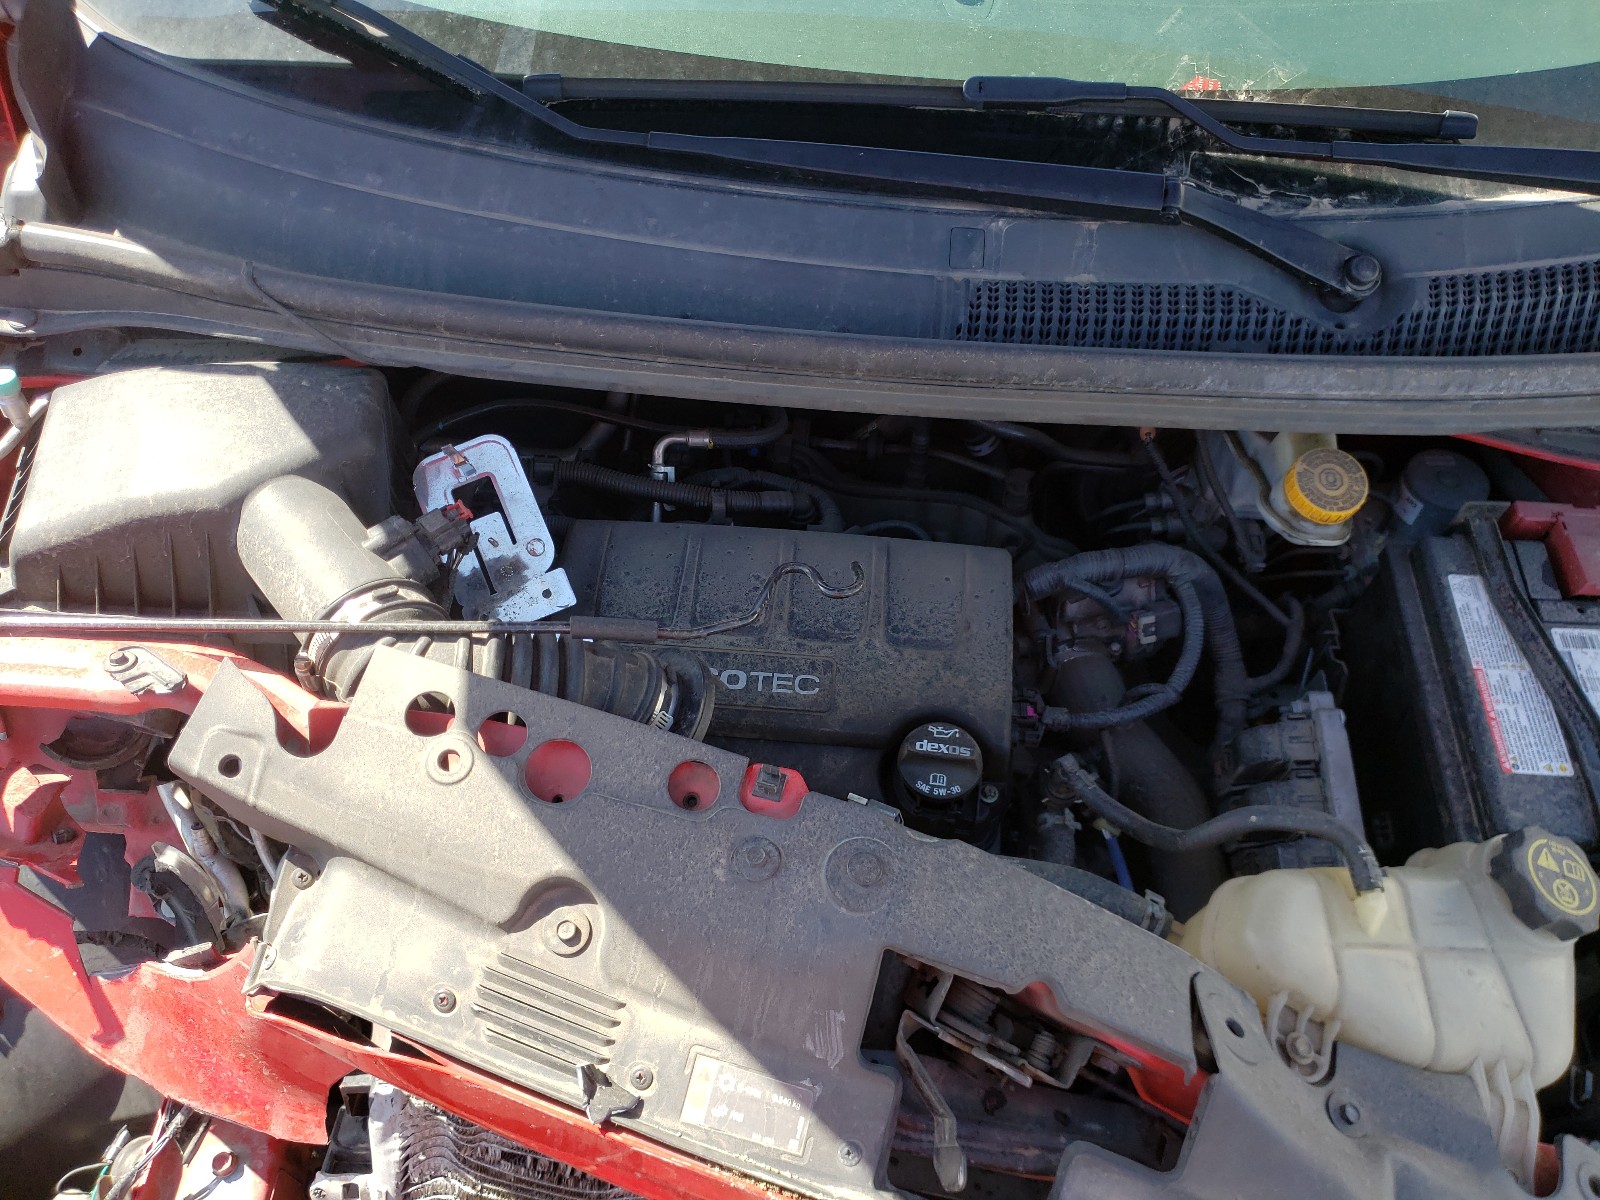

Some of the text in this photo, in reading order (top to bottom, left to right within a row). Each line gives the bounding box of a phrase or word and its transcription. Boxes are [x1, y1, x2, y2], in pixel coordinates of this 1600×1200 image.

[709, 667, 820, 695] OTEC
[915, 740, 971, 757] dexos
[915, 780, 961, 796] SAE 5W-30
